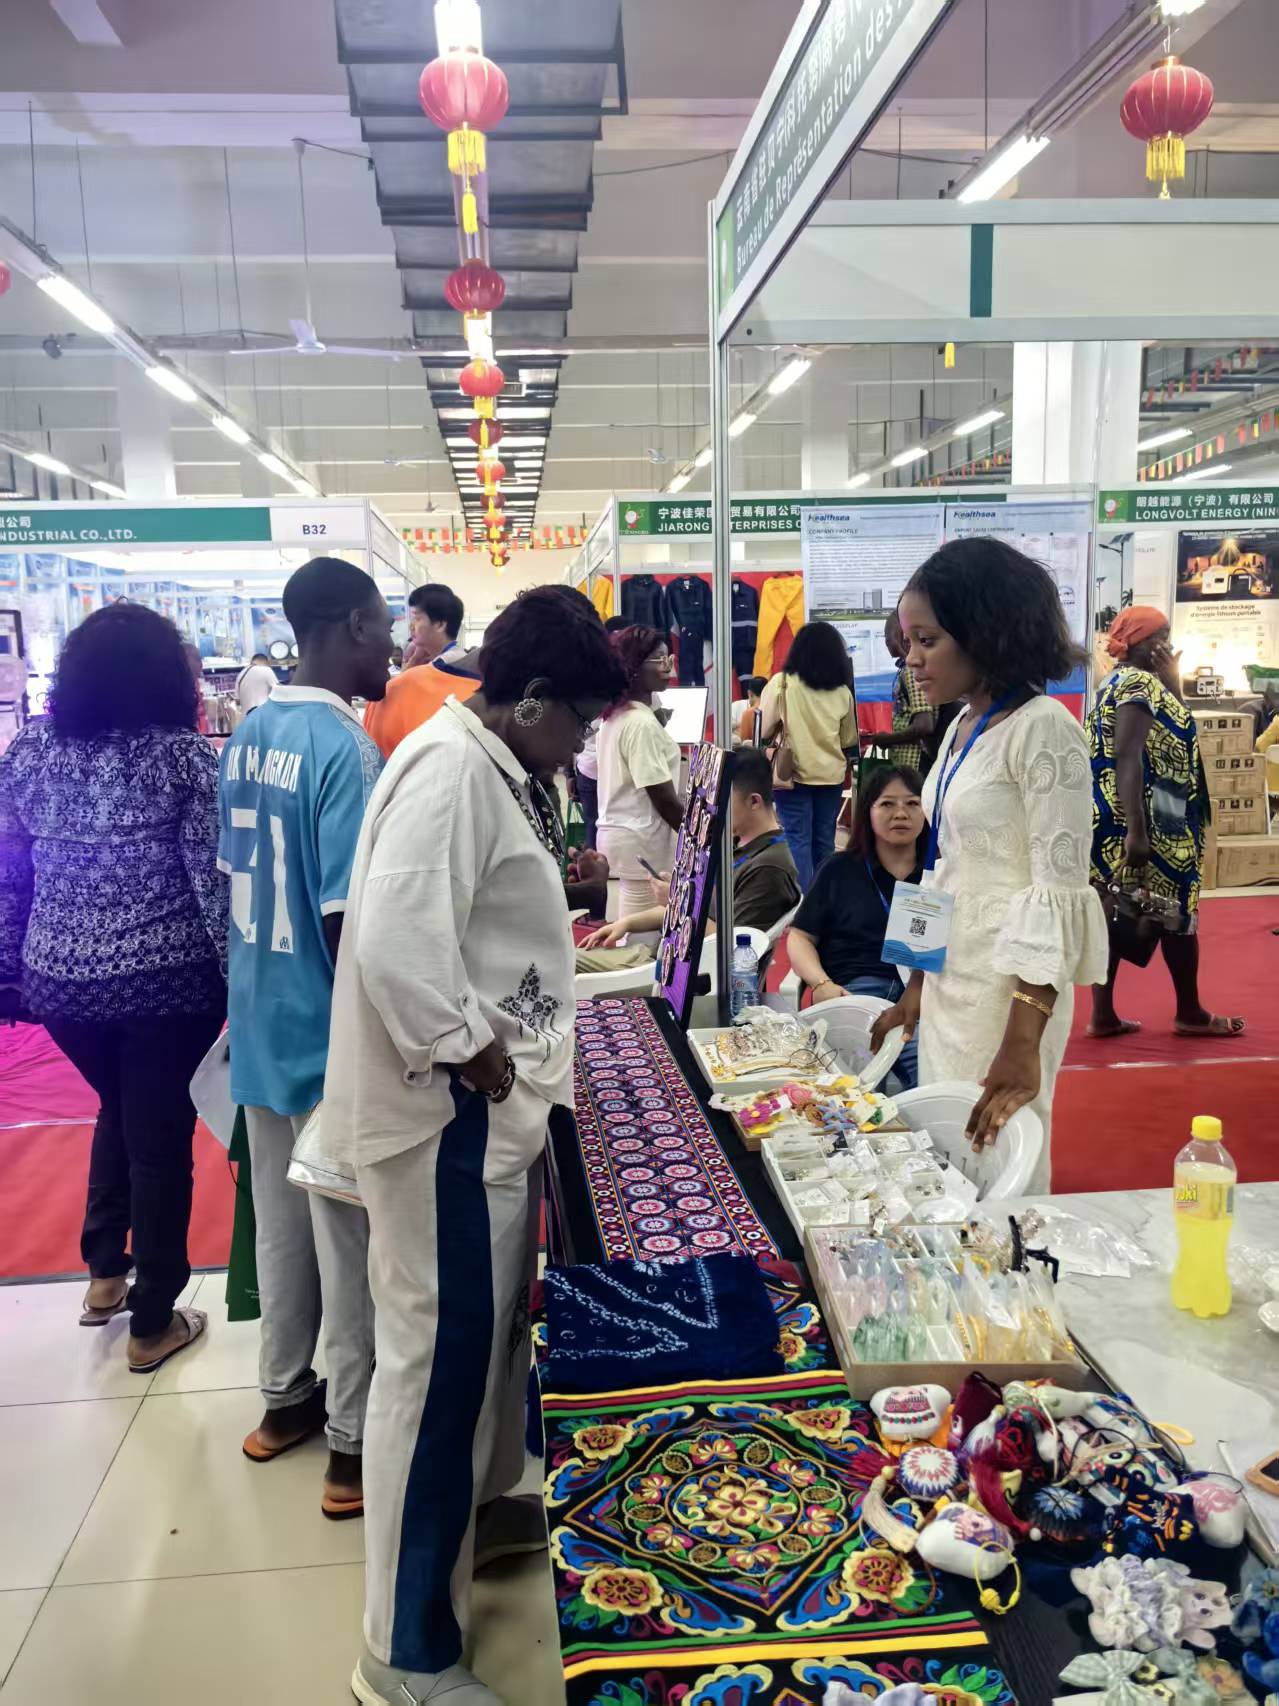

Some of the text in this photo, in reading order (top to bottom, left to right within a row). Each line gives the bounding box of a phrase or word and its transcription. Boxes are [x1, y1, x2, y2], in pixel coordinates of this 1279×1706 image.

[737, 217, 763, 274] Bureau
[764, 195, 775, 229] de
[807, 513, 850, 522] Healthsea
[953, 510, 996, 518] Healthsea
[1135, 507, 1279, 520] LONGVOLT ENERGY (NIN
[302, 523, 327, 535] B32
[658, 521, 710, 532] JIARONG
[729, 519, 793, 531] TERPRISES
[0, 529, 77, 542] NDUSTRIAL
